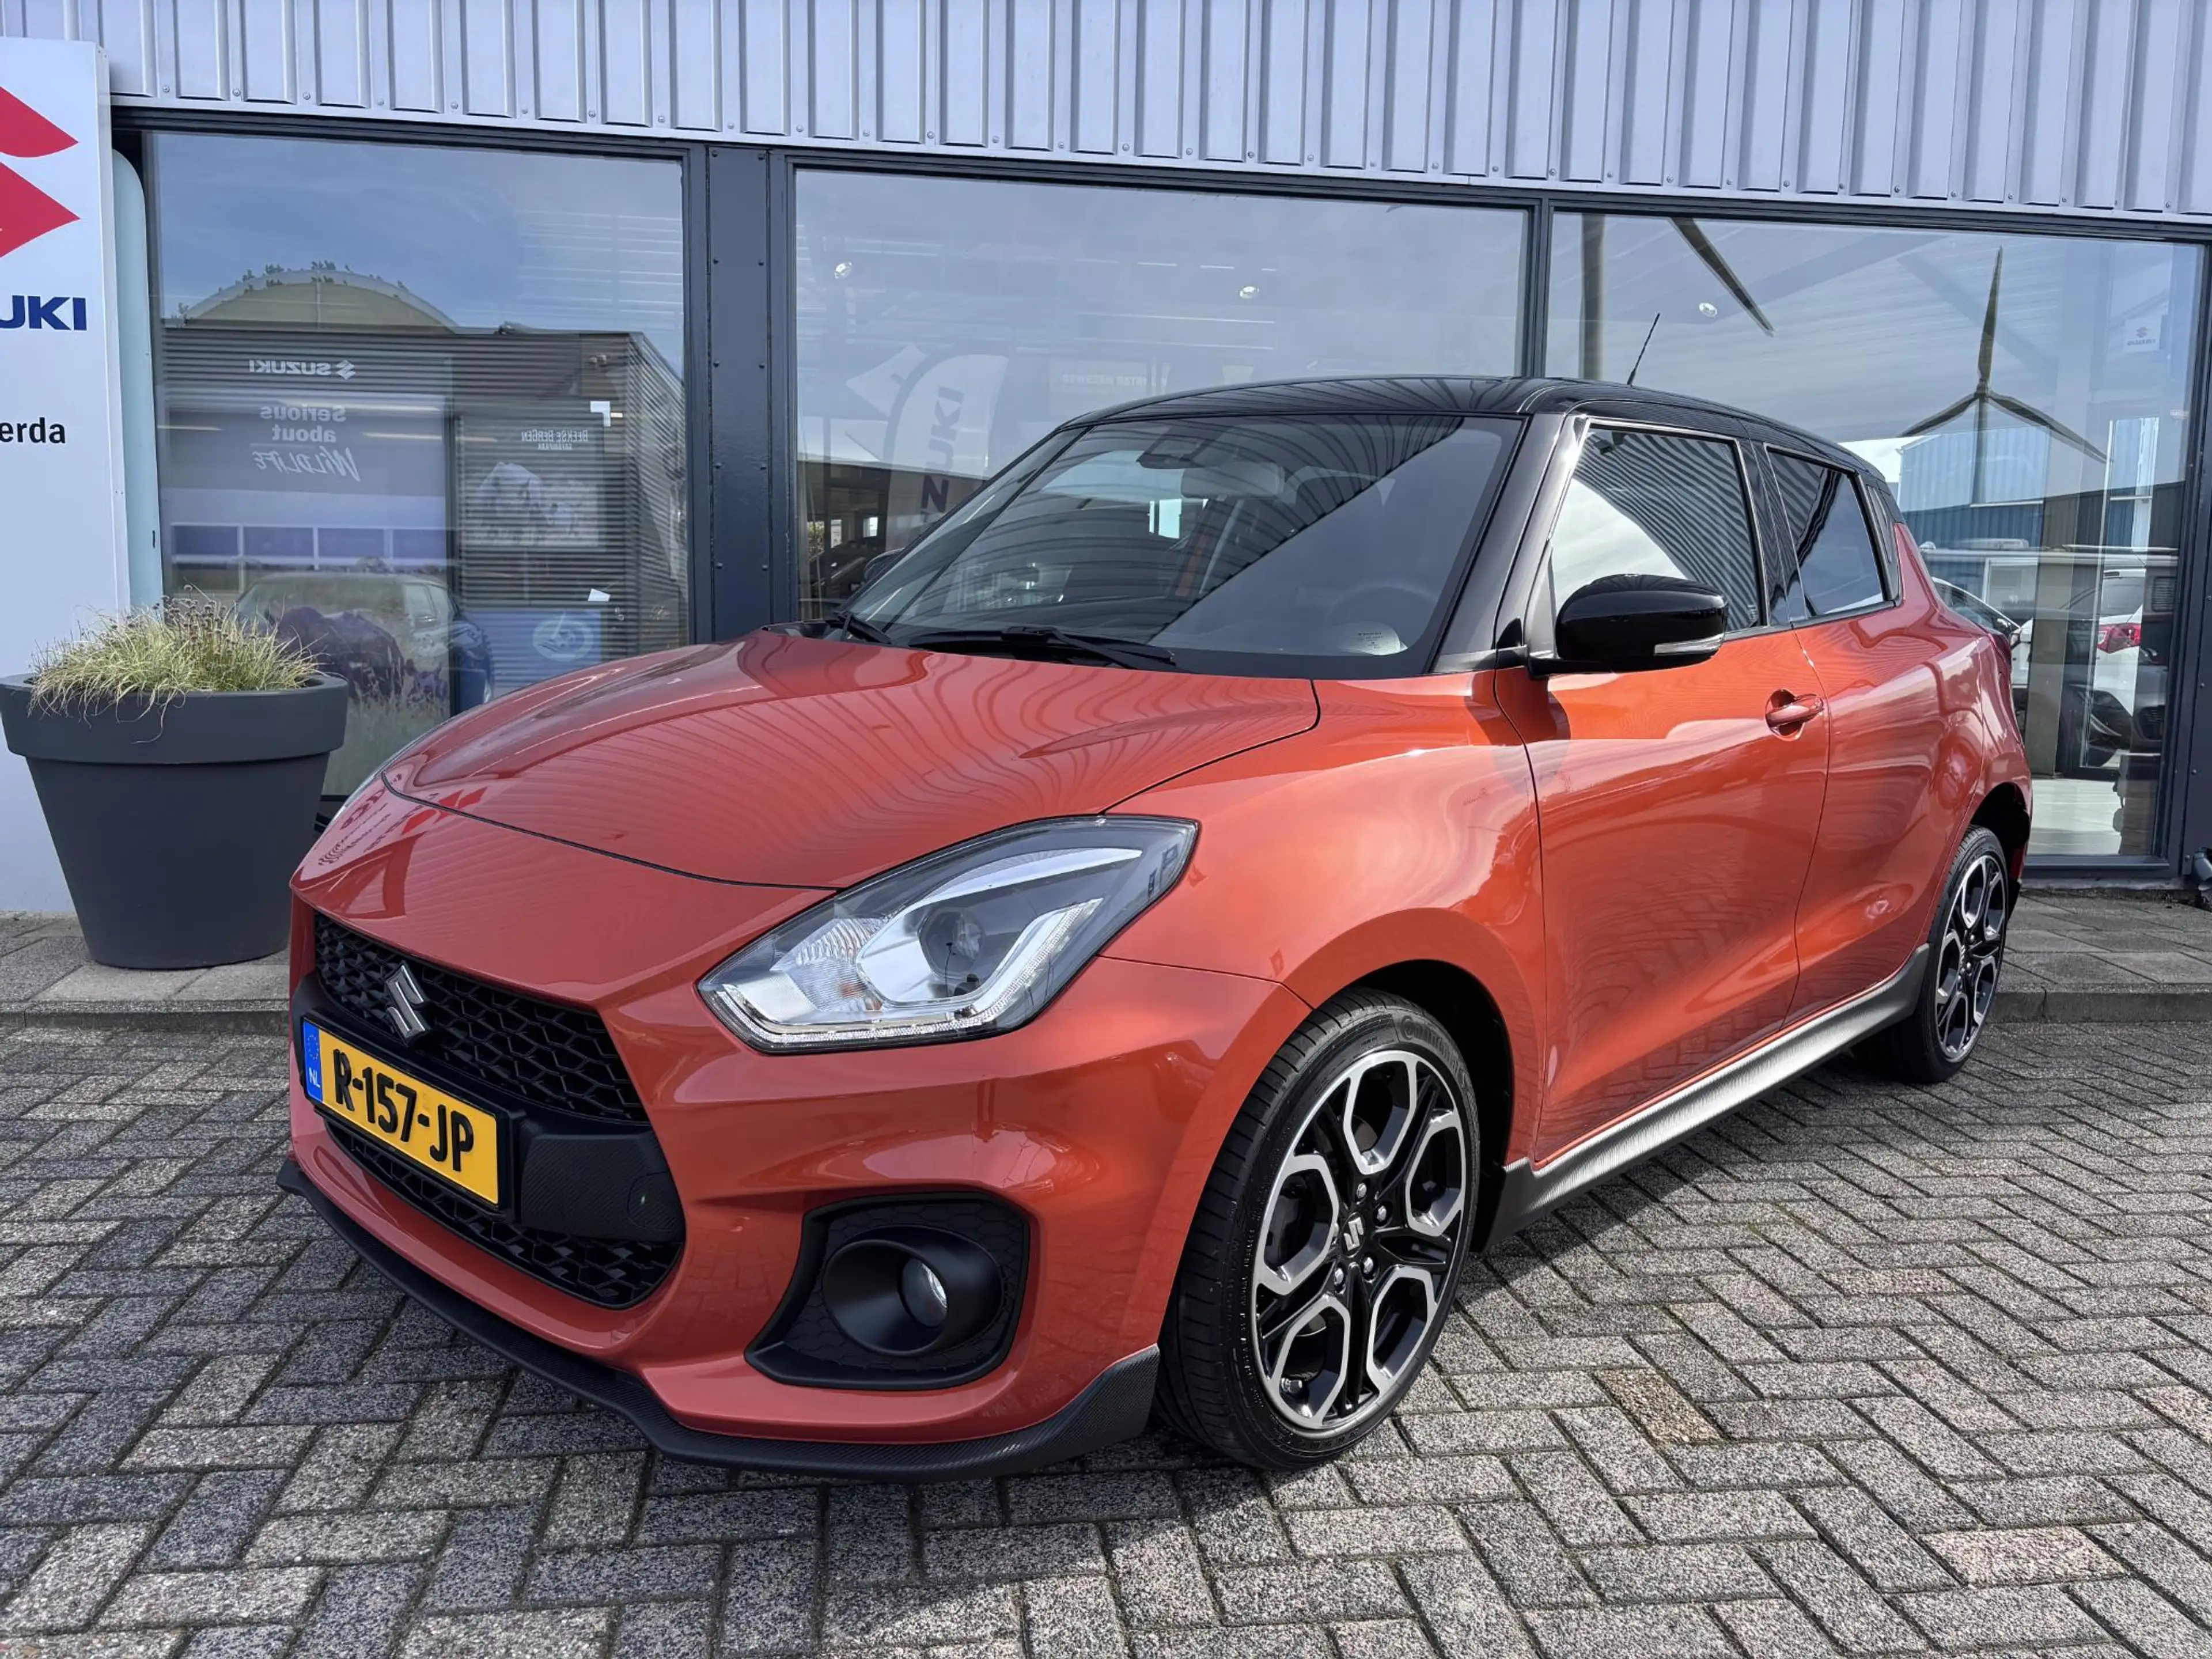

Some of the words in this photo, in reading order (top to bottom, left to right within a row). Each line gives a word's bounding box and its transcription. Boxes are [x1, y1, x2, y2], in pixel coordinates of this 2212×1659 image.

[0, 416, 66, 444] erda
[309, 1067, 321, 1088] NL
[333, 1048, 474, 1172] R-157-JP
